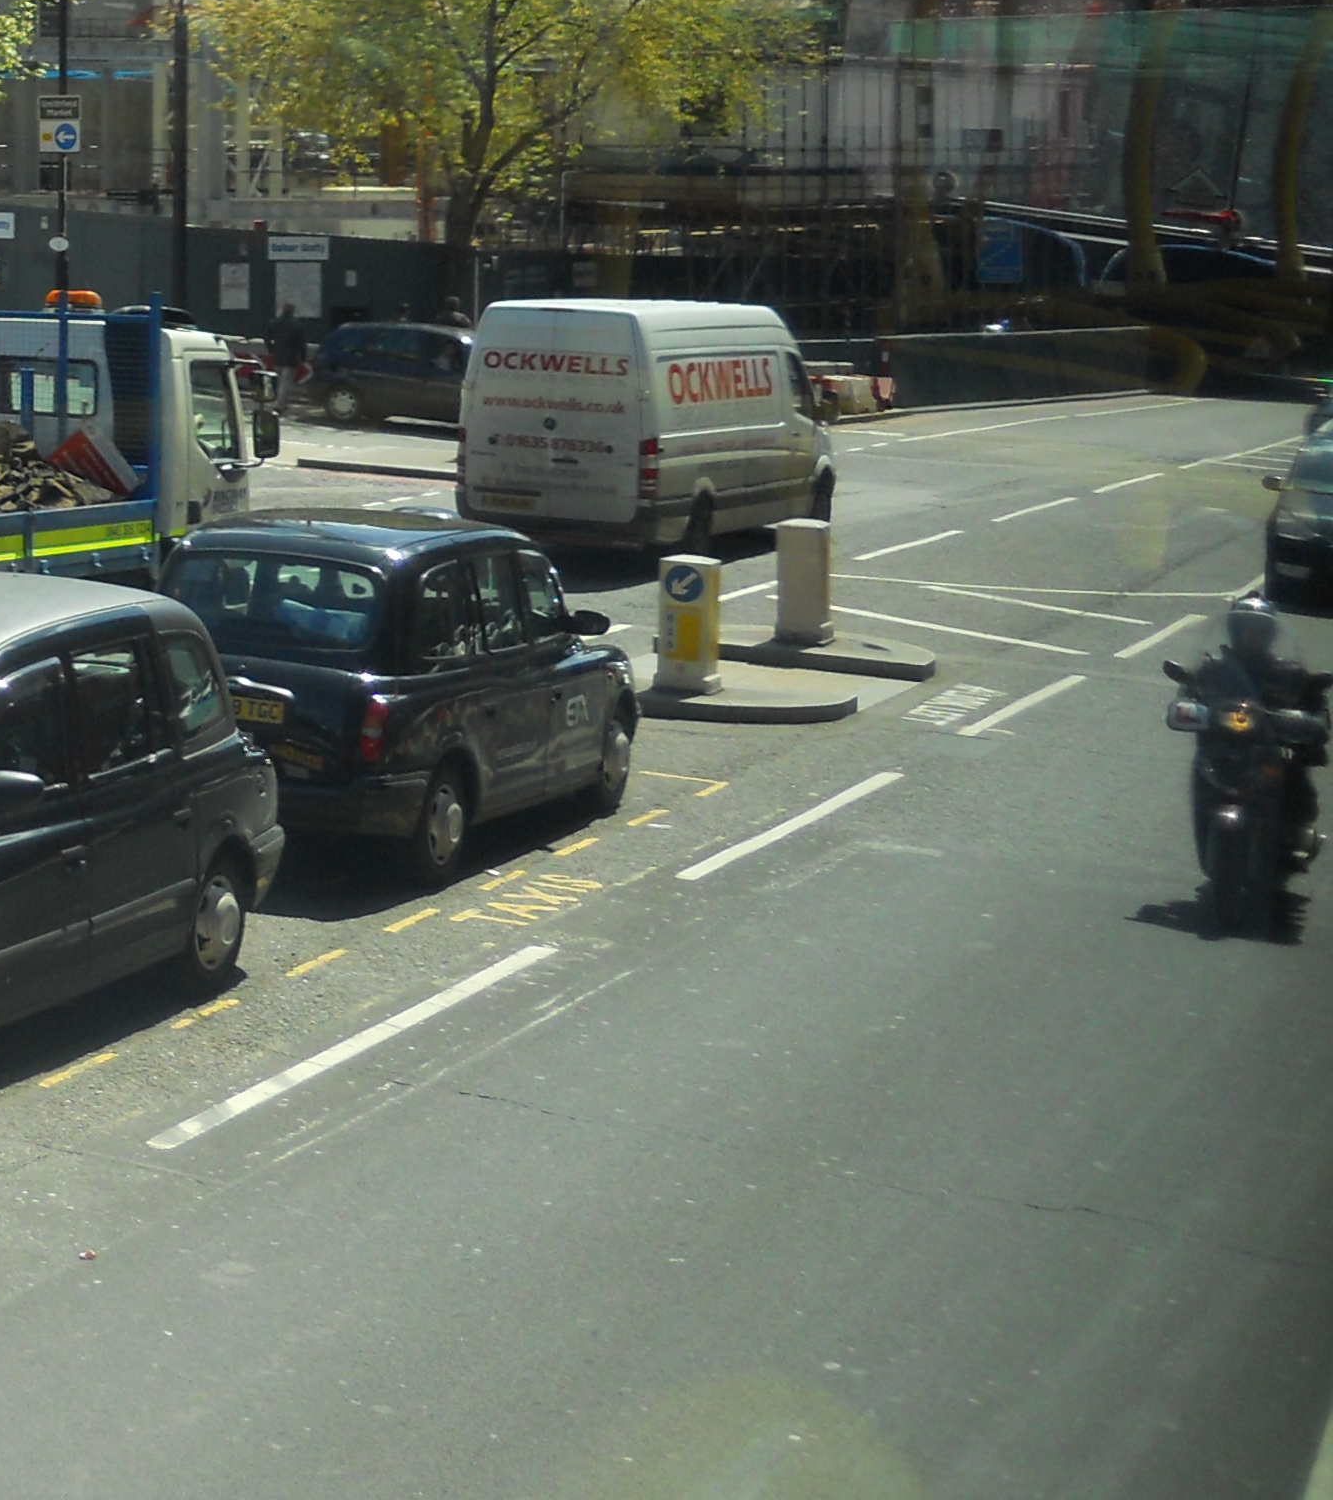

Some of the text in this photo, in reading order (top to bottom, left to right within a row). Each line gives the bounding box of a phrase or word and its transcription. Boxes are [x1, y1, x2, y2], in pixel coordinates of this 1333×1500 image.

[484, 351, 629, 376] OCKWELLS
[668, 358, 773, 405] OCKWELLS
[248, 701, 279, 719] TGC
